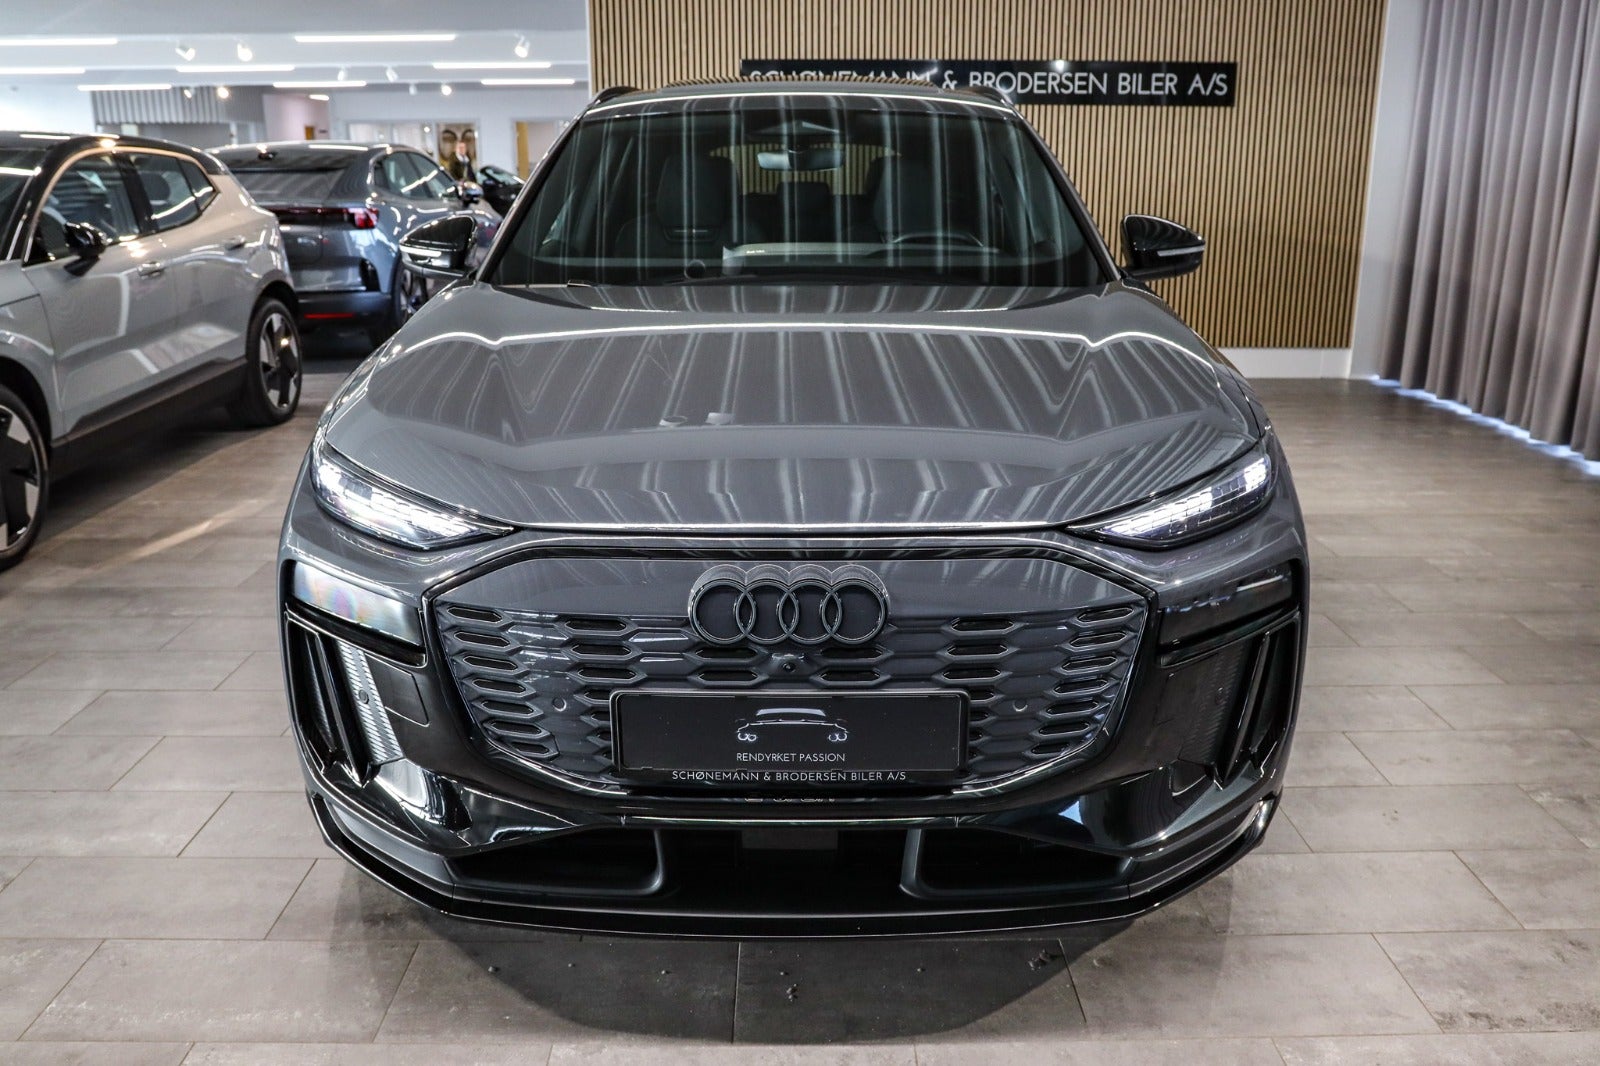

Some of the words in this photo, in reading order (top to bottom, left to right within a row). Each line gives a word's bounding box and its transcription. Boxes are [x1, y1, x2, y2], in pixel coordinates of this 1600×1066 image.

[943, 70, 957, 90] &
[970, 71, 1107, 95] BRODERSEN
[1117, 73, 1178, 95] BILER
[1188, 73, 1228, 96] A/S
[736, 752, 797, 762] RENDYRKET
[799, 752, 846, 762] PASSION
[671, 770, 759, 781] SCHØNEMANN
[763, 771, 771, 781] &
[775, 771, 846, 781] BRODERSEN
[851, 771, 883, 781] BILER
[886, 771, 906, 780] A/S
